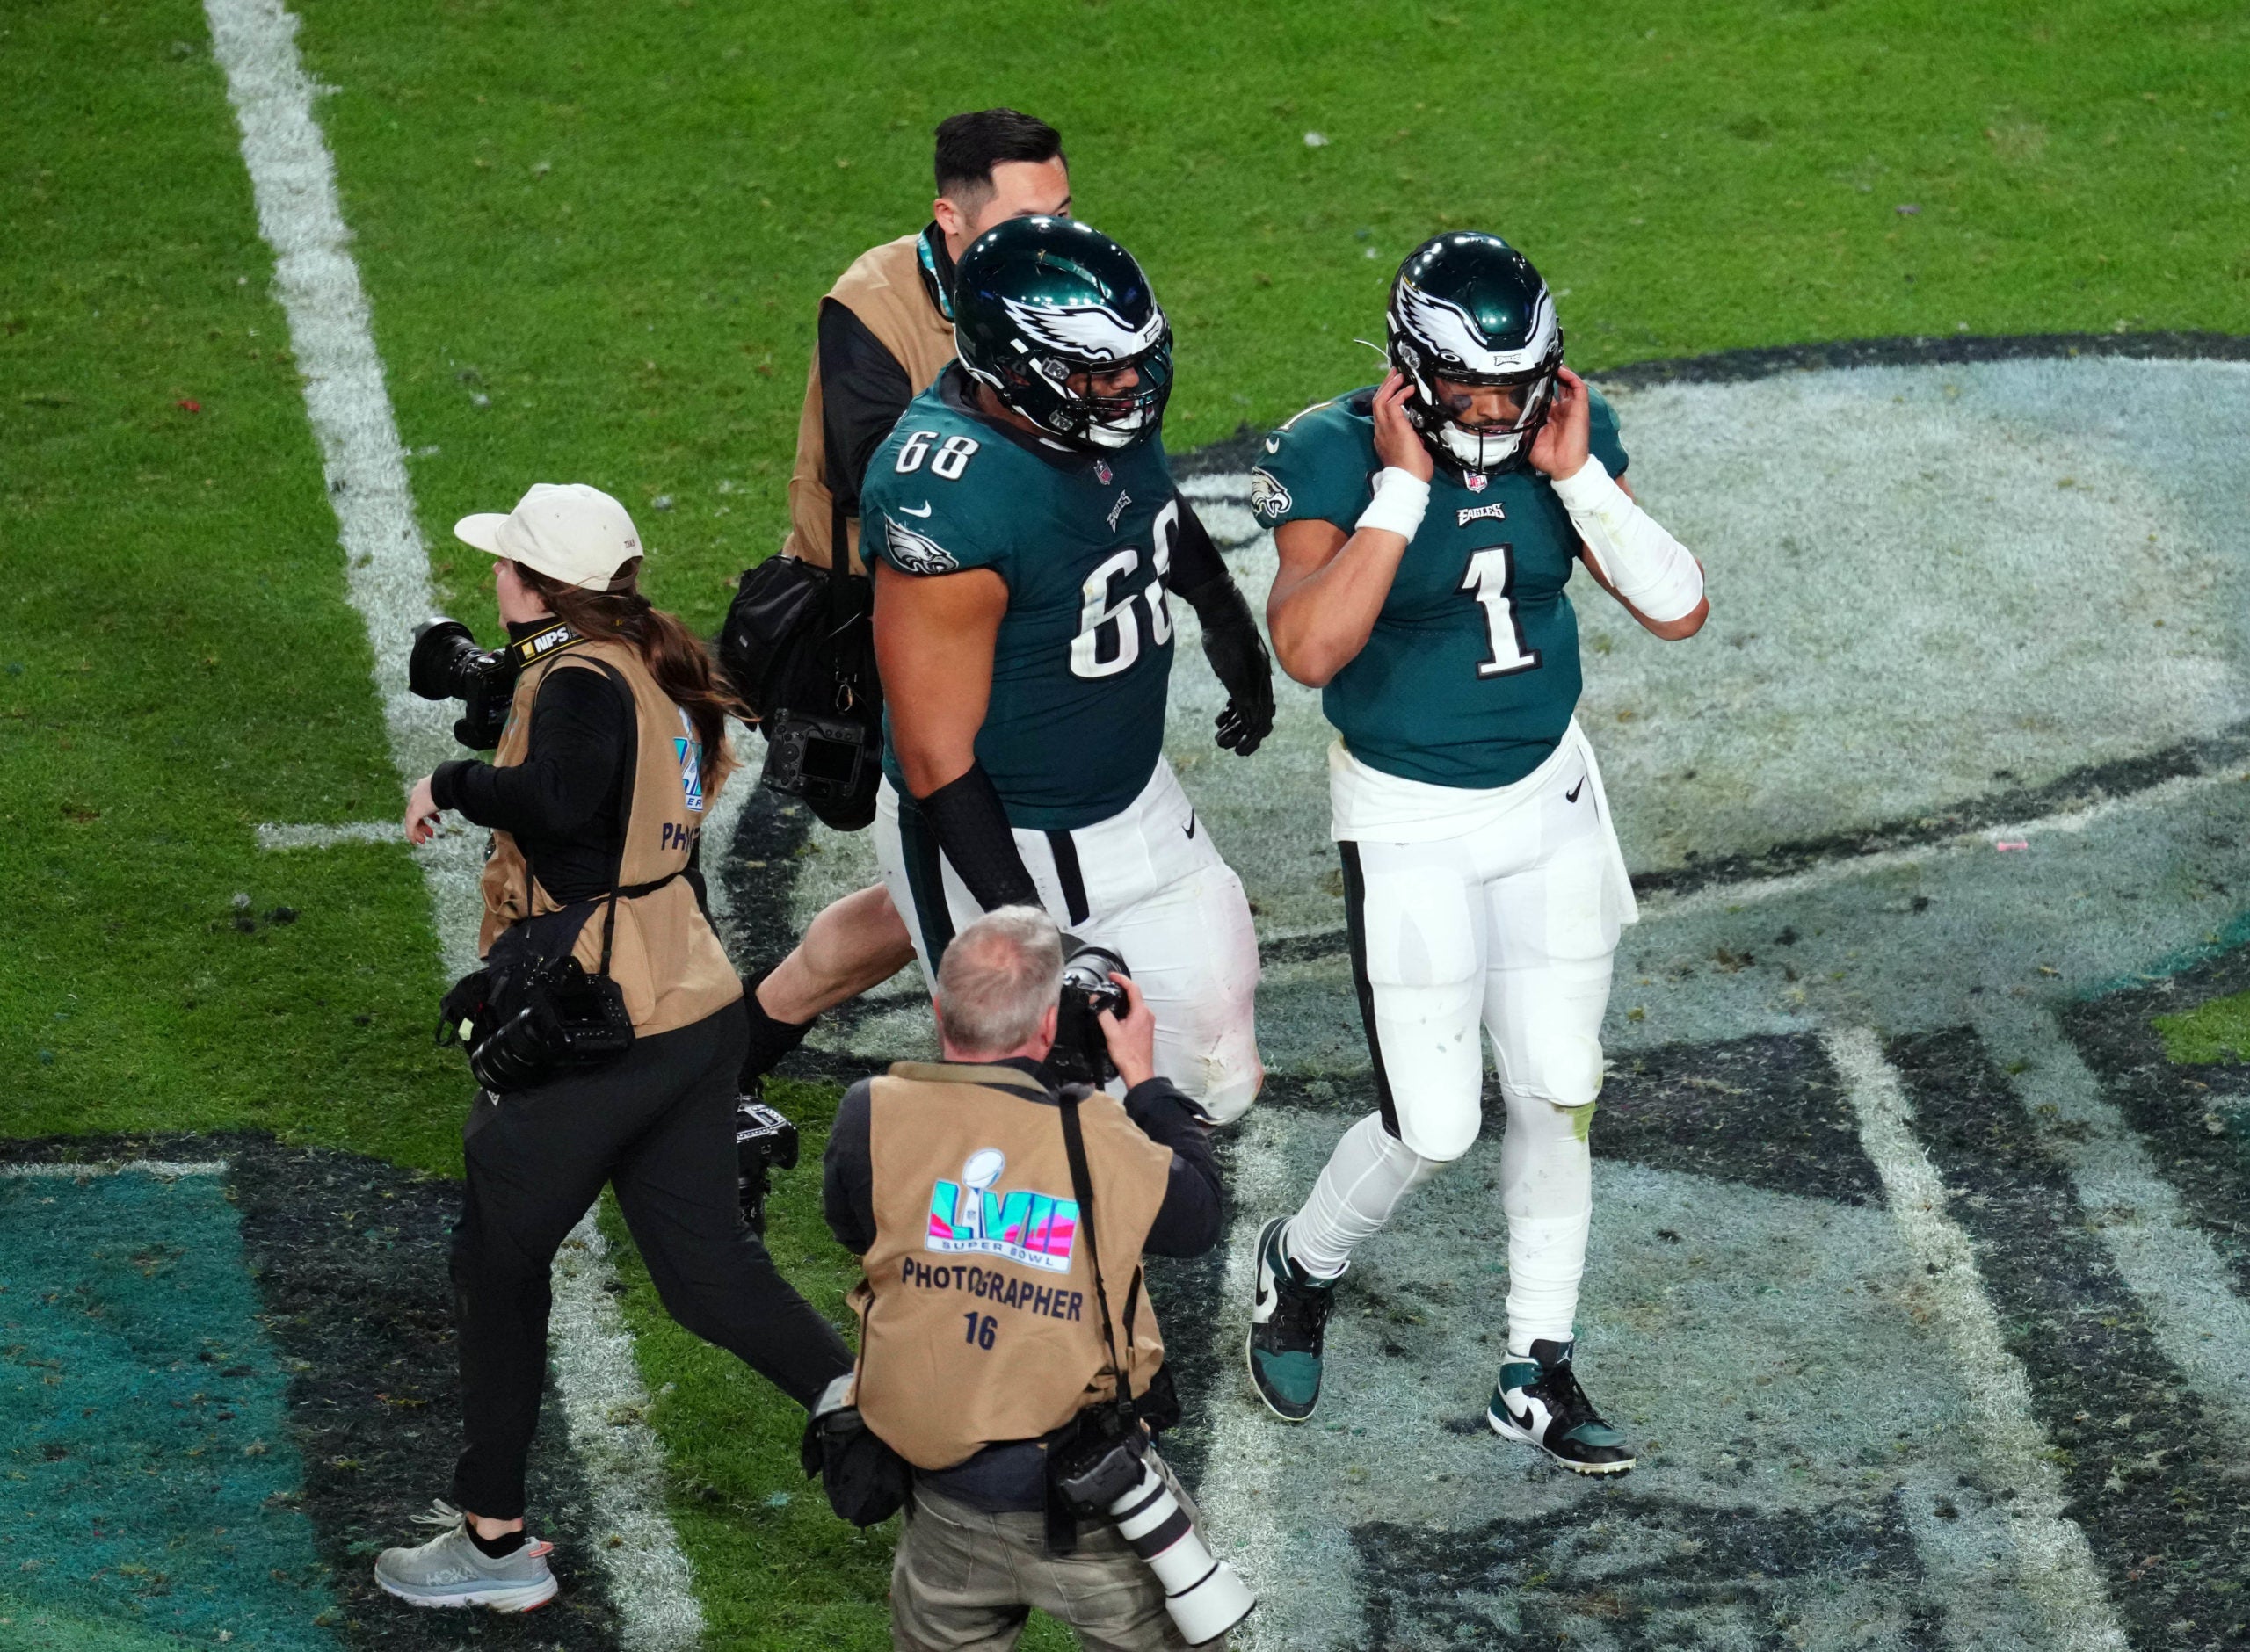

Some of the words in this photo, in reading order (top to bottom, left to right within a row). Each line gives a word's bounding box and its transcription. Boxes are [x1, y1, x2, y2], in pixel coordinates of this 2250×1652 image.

[895, 430, 981, 481] 68
[1455, 502, 1506, 526] EAGLES
[1457, 545, 1539, 677] 1
[533, 627, 570, 653] NPS
[941, 1240, 1003, 1252] SUPER
[1010, 1248, 1054, 1266] BOWL
[902, 1256, 1084, 1322] PHOTOGRAPHER
[963, 1311, 998, 1351] 16
